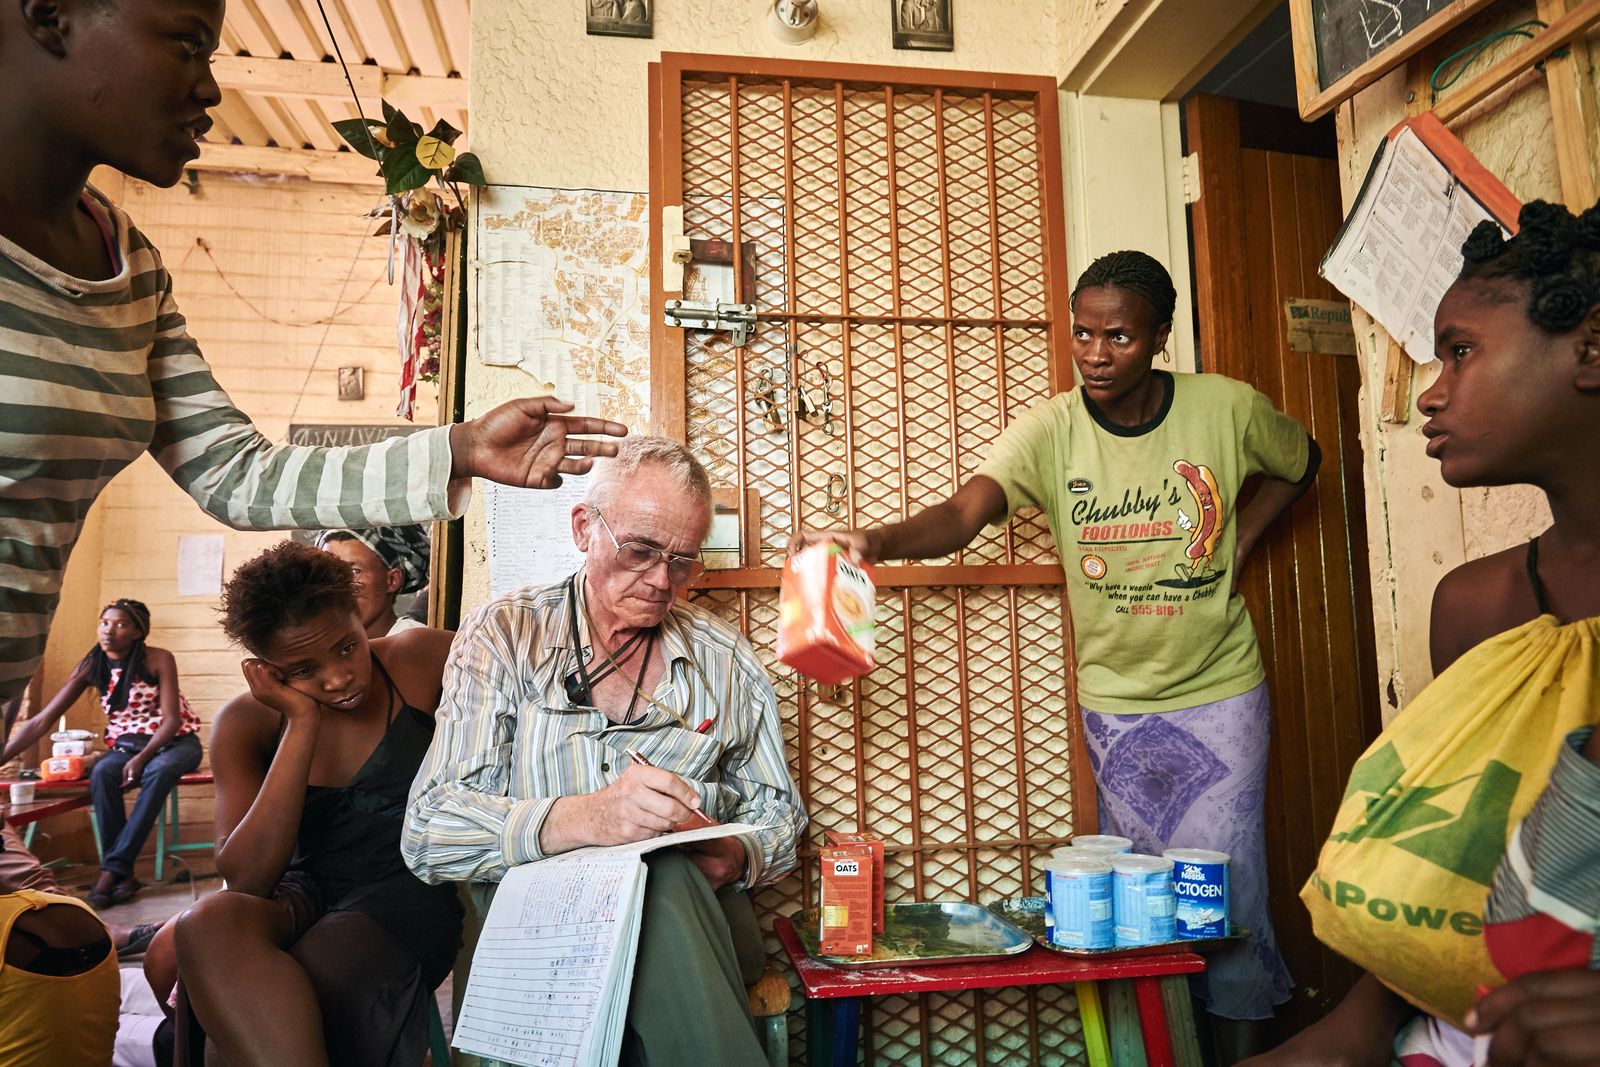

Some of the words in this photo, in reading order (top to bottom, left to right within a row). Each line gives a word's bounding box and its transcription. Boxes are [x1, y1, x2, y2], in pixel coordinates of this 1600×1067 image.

[1071, 479, 1182, 525] Chubby's
[1081, 520, 1173, 541] FOOTLONGS
[1105, 583, 1121, 591] have
[1108, 590, 1127, 600] when
[1129, 595, 1144, 604] you
[1163, 592, 1182, 602] have
[1115, 605, 1129, 613] CALL
[836, 864, 857, 872] OATS
